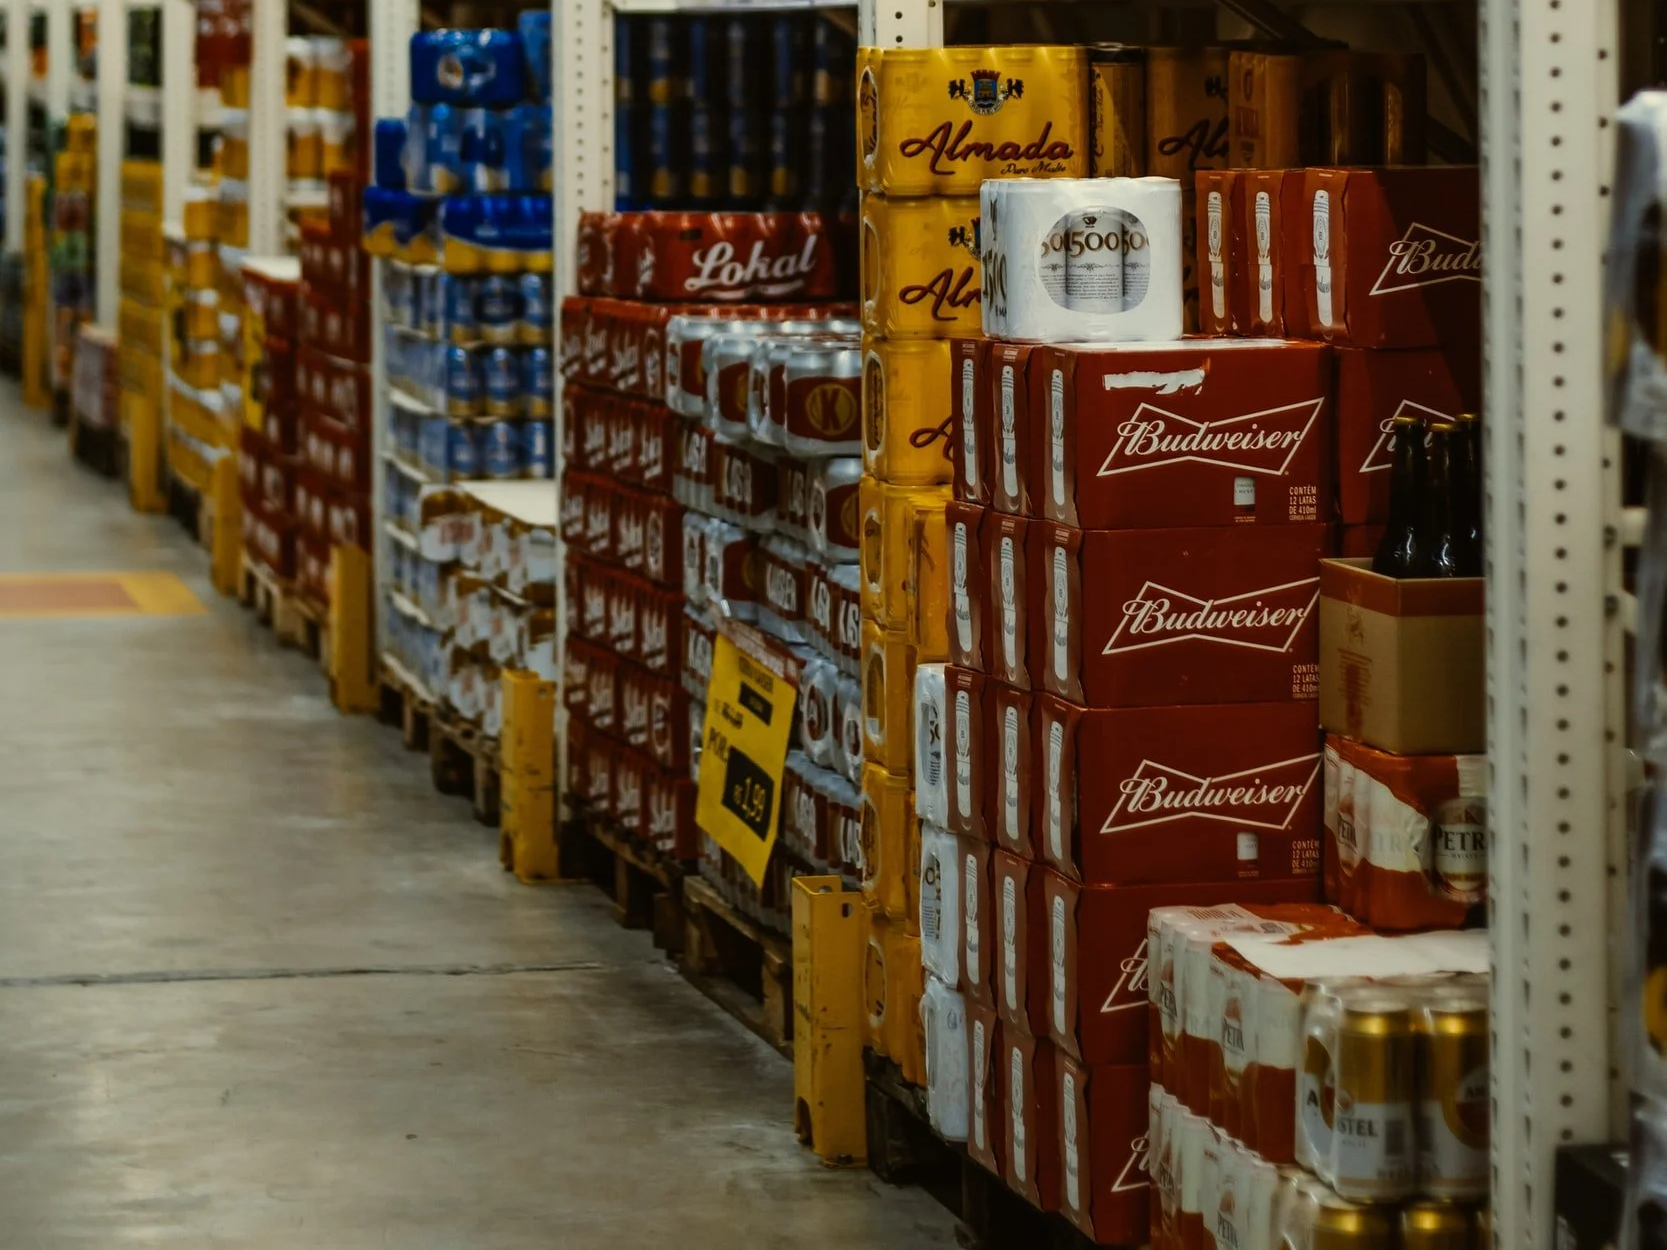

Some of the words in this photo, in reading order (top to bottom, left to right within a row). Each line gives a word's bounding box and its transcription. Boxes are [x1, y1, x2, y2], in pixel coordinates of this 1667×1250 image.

[899, 119, 1074, 175] Almada
[685, 234, 818, 292] Lokal
[1117, 420, 1302, 456] Budweiser
[1289, 484, 1317, 496] CONTÉM
[1289, 496, 1297, 505] 12
[1299, 495, 1317, 505] LATAS
[1289, 506, 1297, 515] DE
[1122, 598, 1305, 634] Budweiser
[1119, 776, 1305, 813] Budweiser
[1436, 826, 1487, 852] PETR
